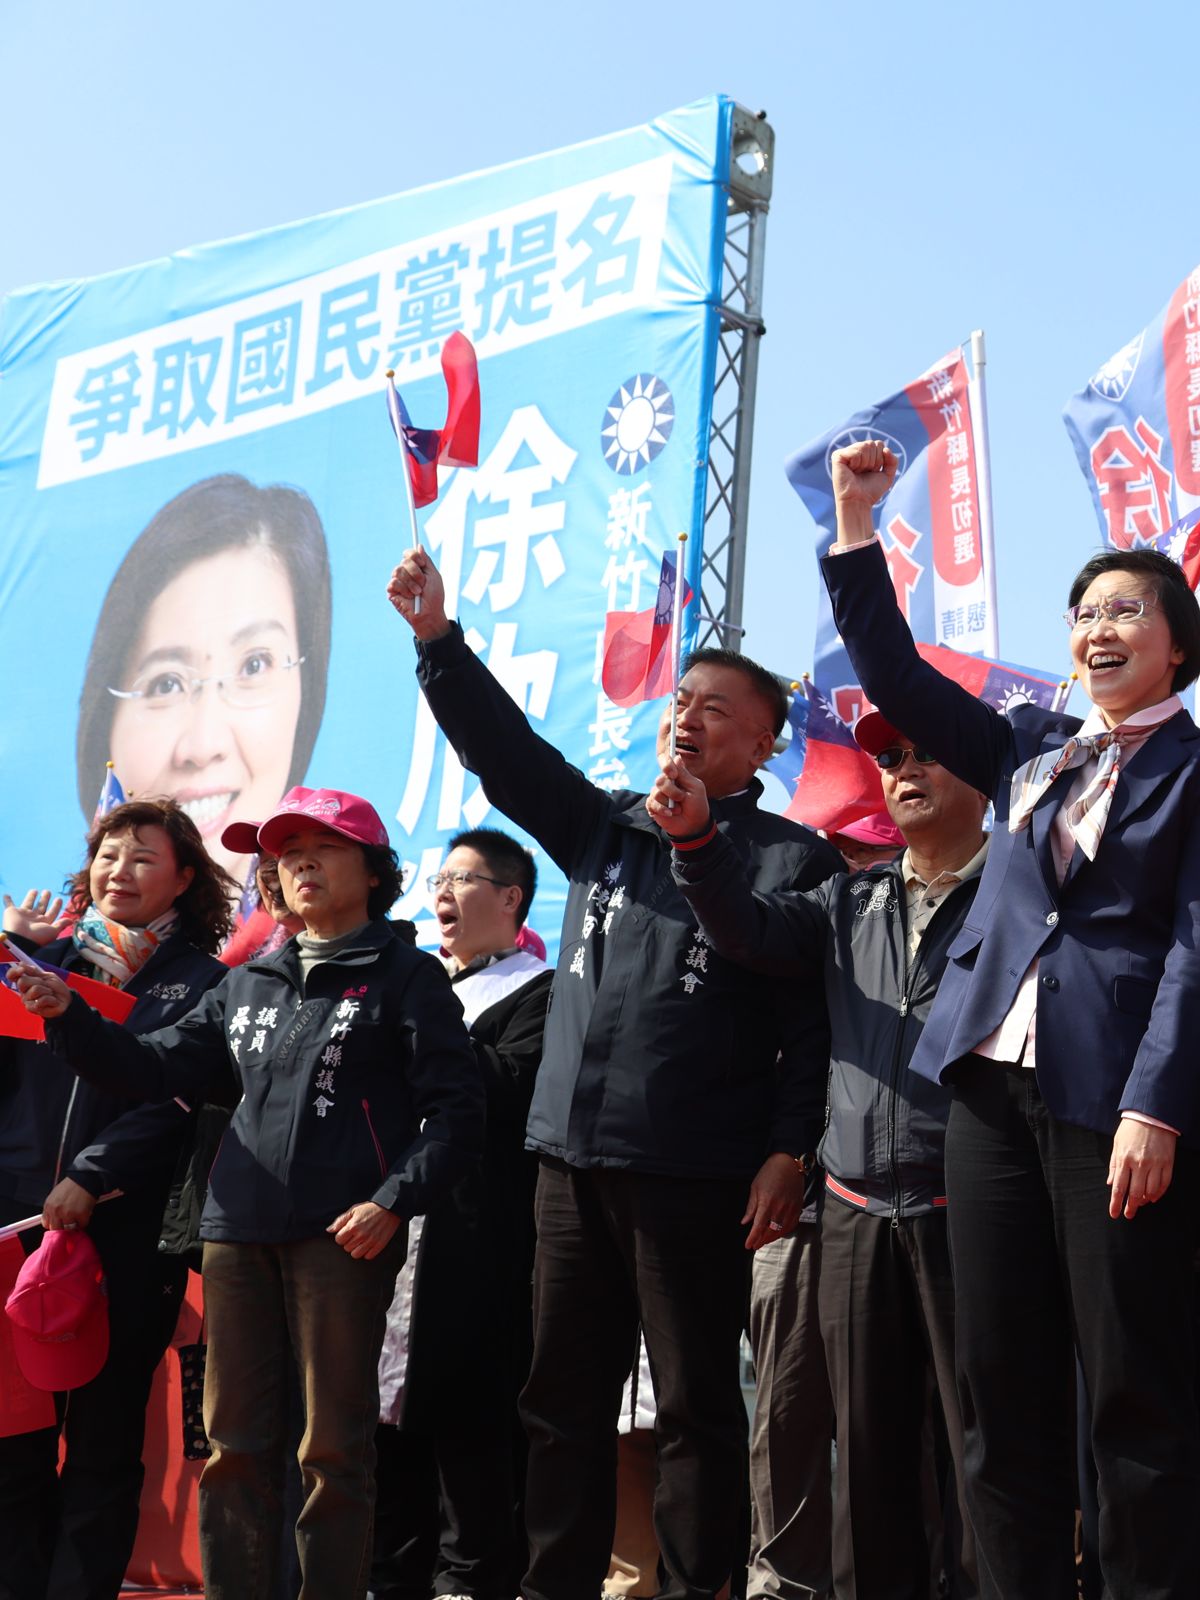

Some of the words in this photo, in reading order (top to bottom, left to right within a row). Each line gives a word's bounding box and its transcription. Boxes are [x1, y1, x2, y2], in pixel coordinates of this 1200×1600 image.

[68, 190, 642, 463] 爭取國民黨提名
[247, 1007, 279, 1054] 議員
[312, 999, 360, 1118] 新竹縣議會
